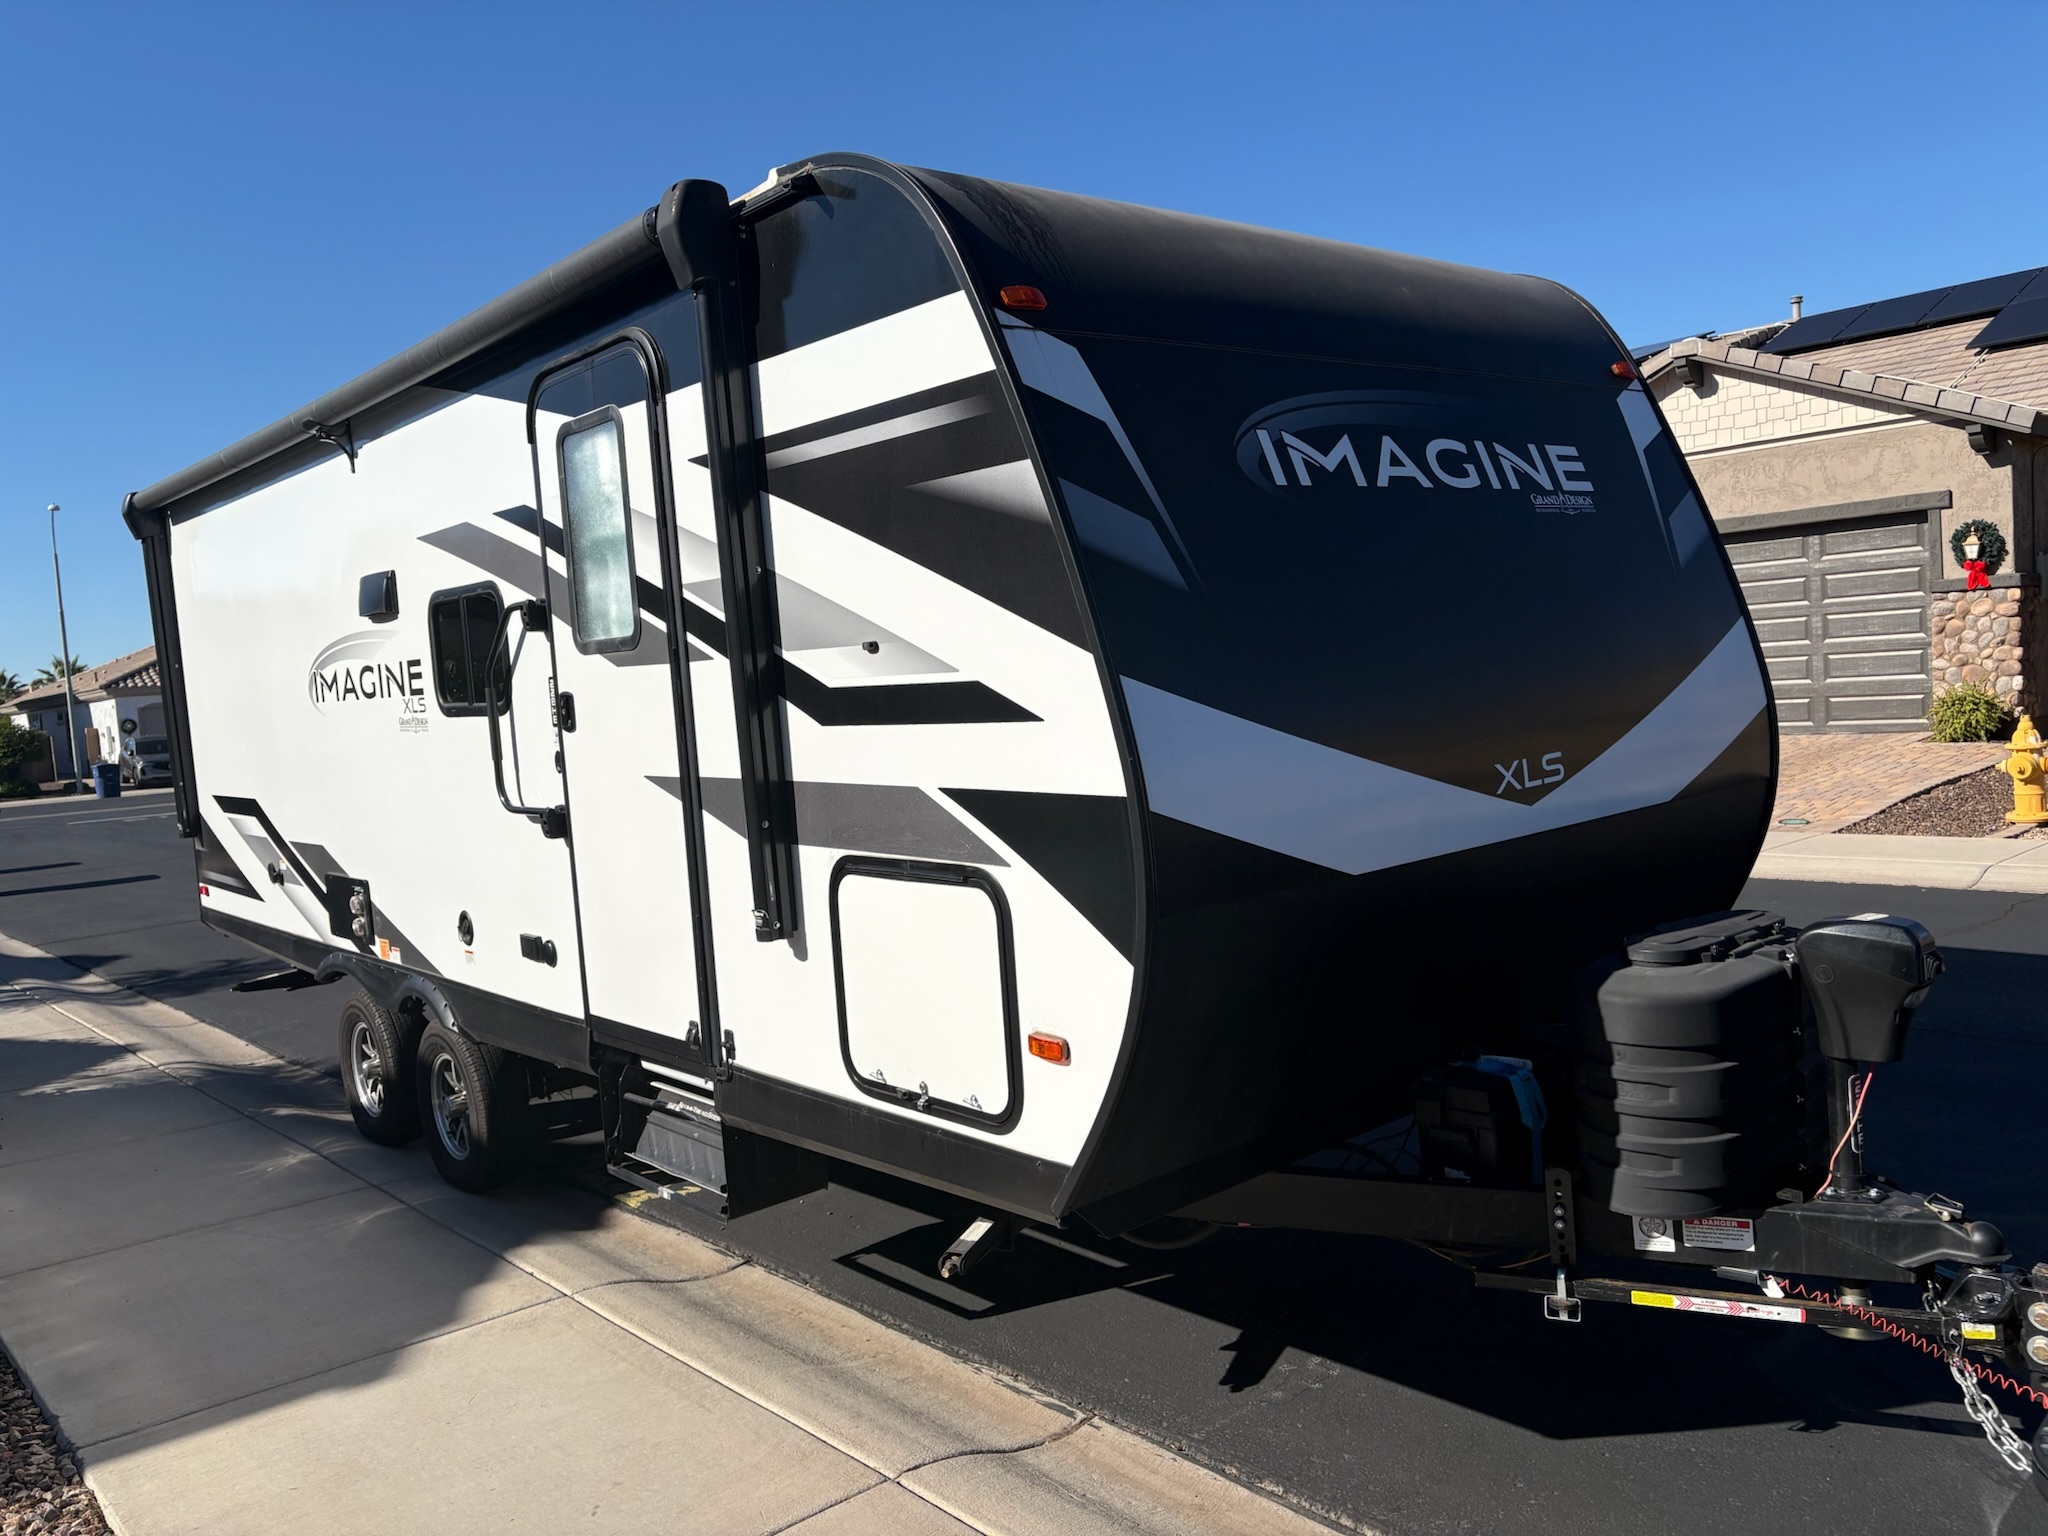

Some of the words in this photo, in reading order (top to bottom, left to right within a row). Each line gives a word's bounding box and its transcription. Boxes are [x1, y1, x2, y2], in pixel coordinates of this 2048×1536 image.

[1255, 428, 1595, 492] IMAGINE
[1530, 493, 1560, 505] GRAND
[1564, 494, 1594, 505] DESIGN
[313, 659, 424, 703] IMAGINE
[402, 697, 427, 714] XLS
[1494, 751, 1566, 795] XLS
[1701, 1219, 1738, 1228] DANGER
